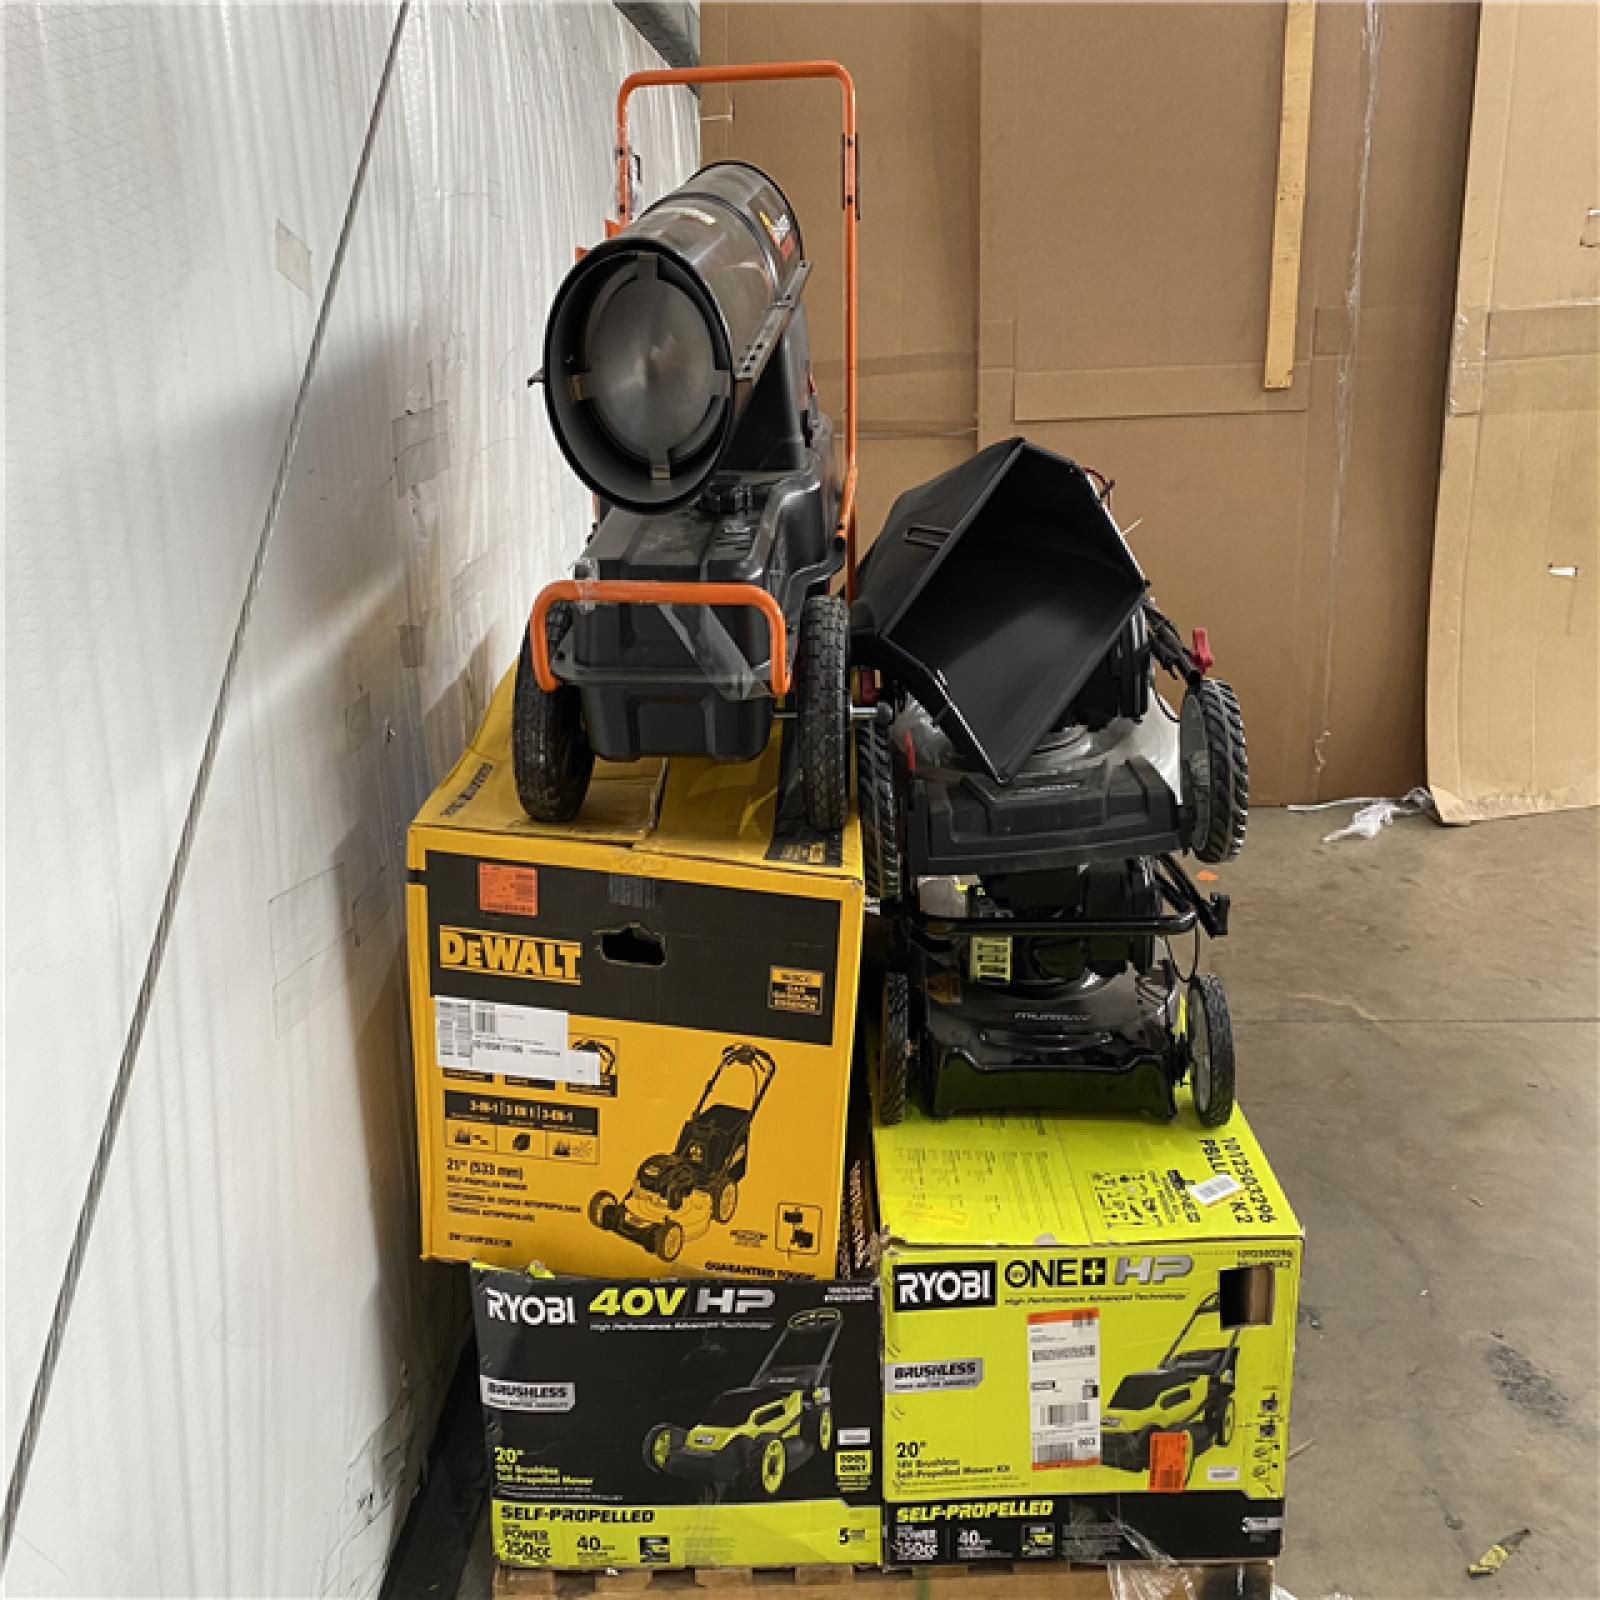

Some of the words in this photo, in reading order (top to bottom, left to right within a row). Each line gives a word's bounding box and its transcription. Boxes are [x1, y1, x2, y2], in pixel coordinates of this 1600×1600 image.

[1113, 1254, 1193, 1285] HP
[896, 1269, 992, 1304] RYOBI
[486, 1286, 577, 1326] RYOBI
[588, 1286, 688, 1317] 40V
[695, 1287, 776, 1314] HP
[894, 1361, 976, 1380] BRUSHLESS
[487, 1381, 568, 1398] BRUSHLESS
[896, 1440, 928, 1458] 20"
[501, 1504, 655, 1523] SELF-PROPELLED
[896, 1500, 1054, 1523] SELF-PROPELLED
[576, 1535, 601, 1551] 40
